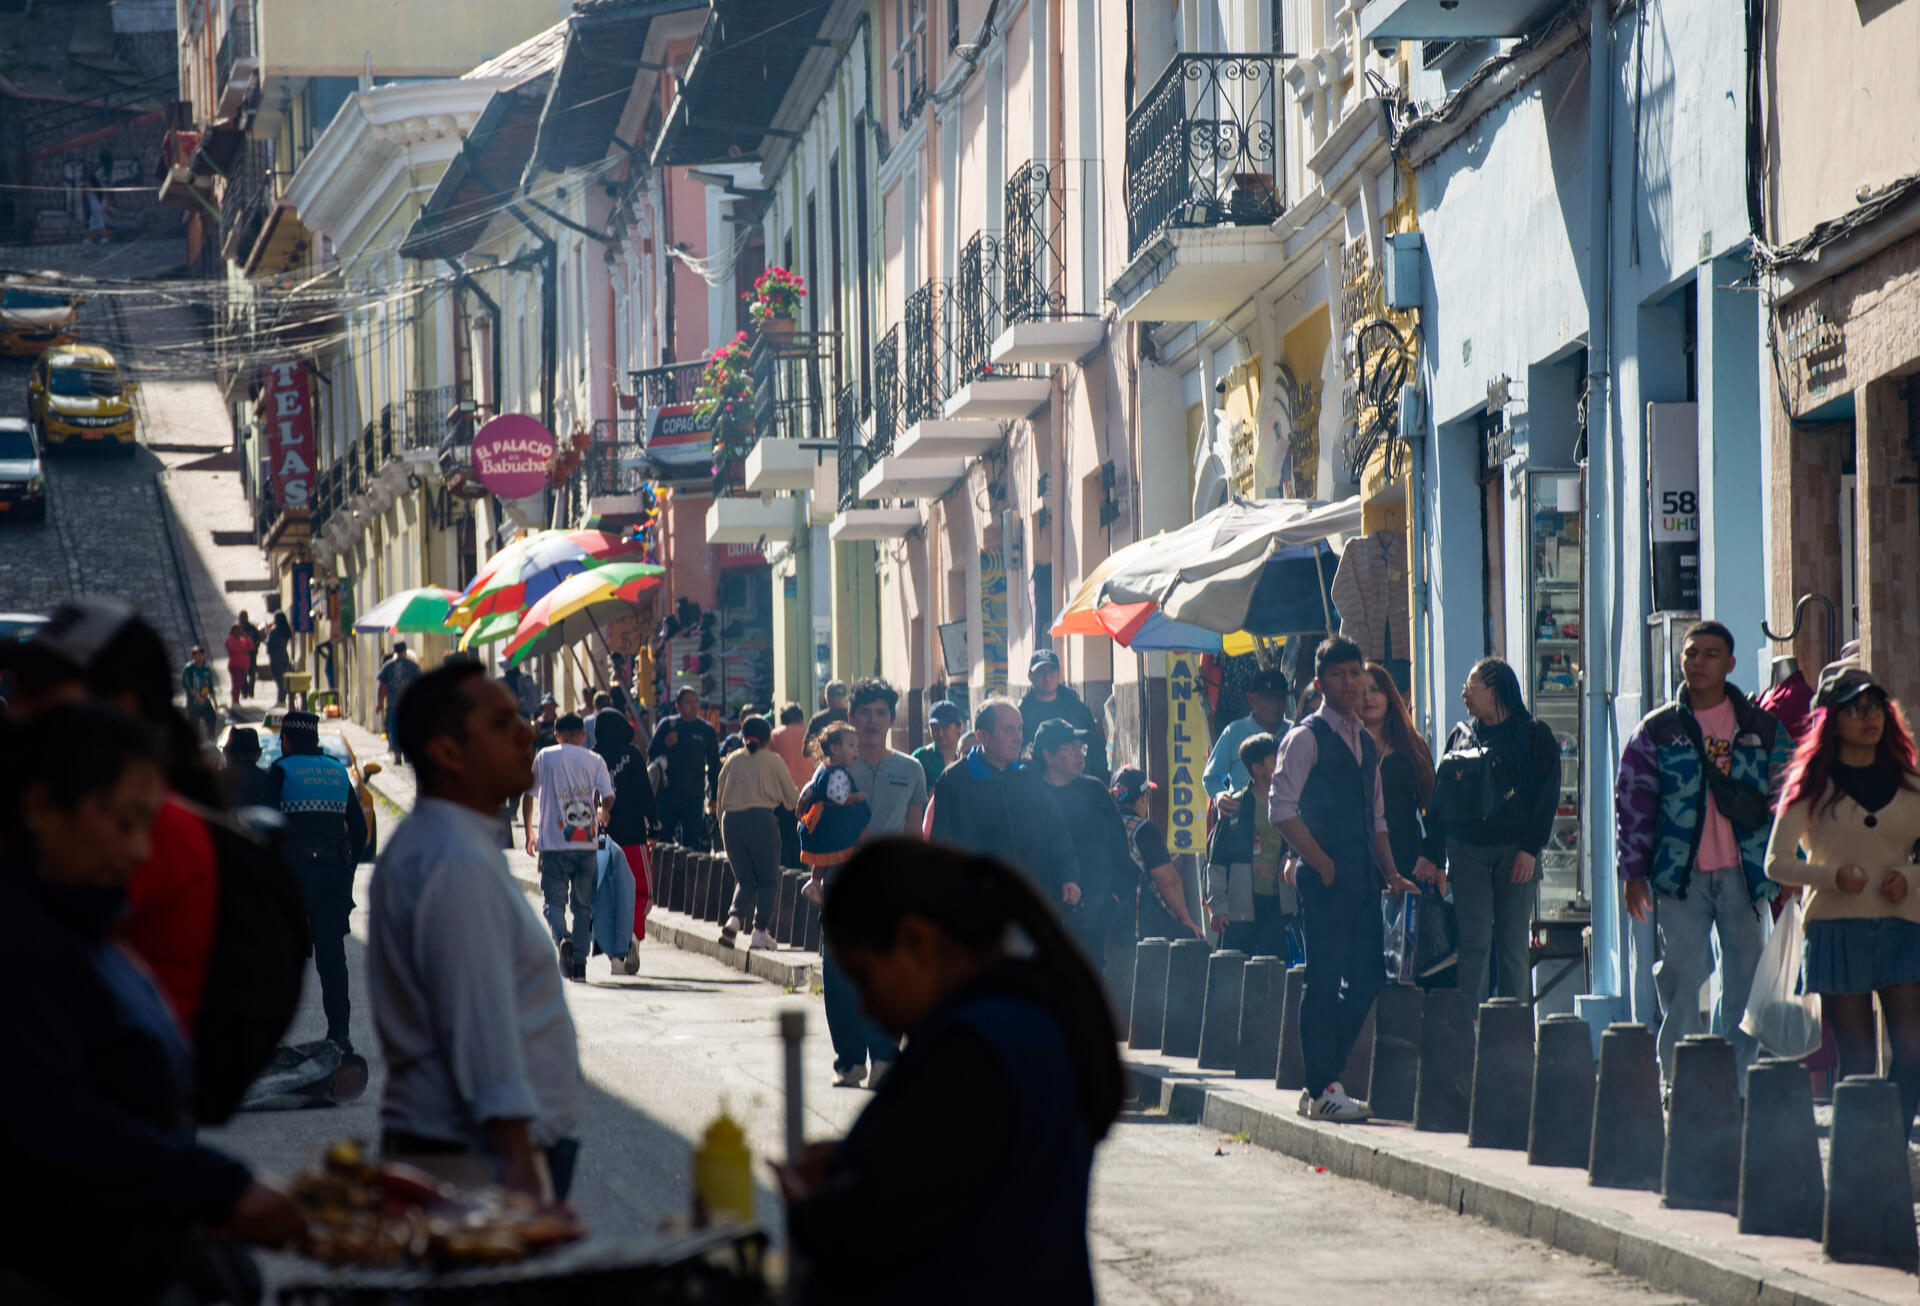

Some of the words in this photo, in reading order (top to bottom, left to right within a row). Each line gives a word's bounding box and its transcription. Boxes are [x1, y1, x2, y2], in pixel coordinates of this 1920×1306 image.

[271, 361, 310, 505] TELAS
[475, 445, 492, 460] EL
[492, 440, 553, 458] PALACIO
[663, 414, 695, 434] COPAG
[1171, 660, 1194, 848] ANILLADOS
